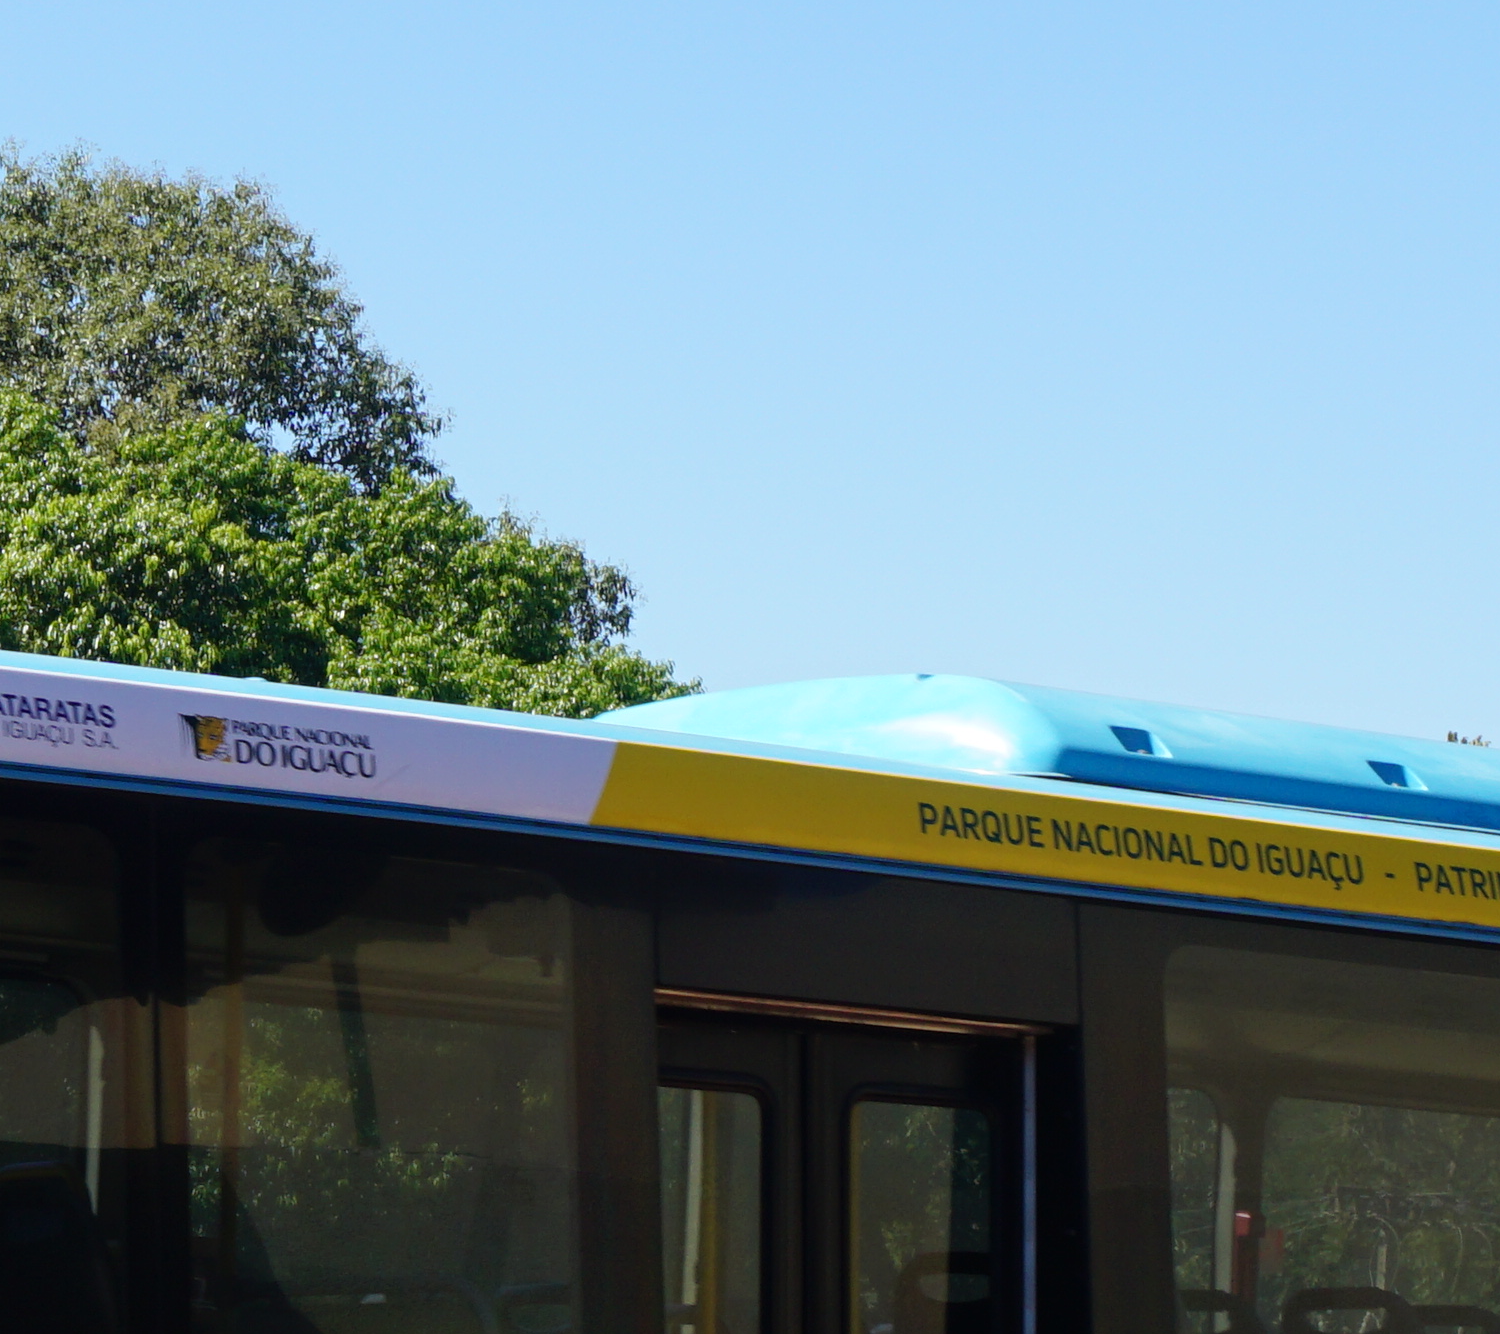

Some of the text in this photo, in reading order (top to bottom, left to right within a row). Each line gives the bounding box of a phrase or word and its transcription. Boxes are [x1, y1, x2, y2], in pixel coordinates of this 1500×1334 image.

[3, 720, 75, 748] IGUAÇU
[82, 728, 119, 750] S.A.
[231, 719, 374, 750] PARQUE NACIONAL
[235, 738, 377, 779] DO IGUAÇU
[917, 801, 1043, 849] PARQUE
[1052, 817, 1204, 867] NACIONAL
[1208, 836, 1250, 871] DO
[1256, 842, 1365, 891] IGUAÇU
